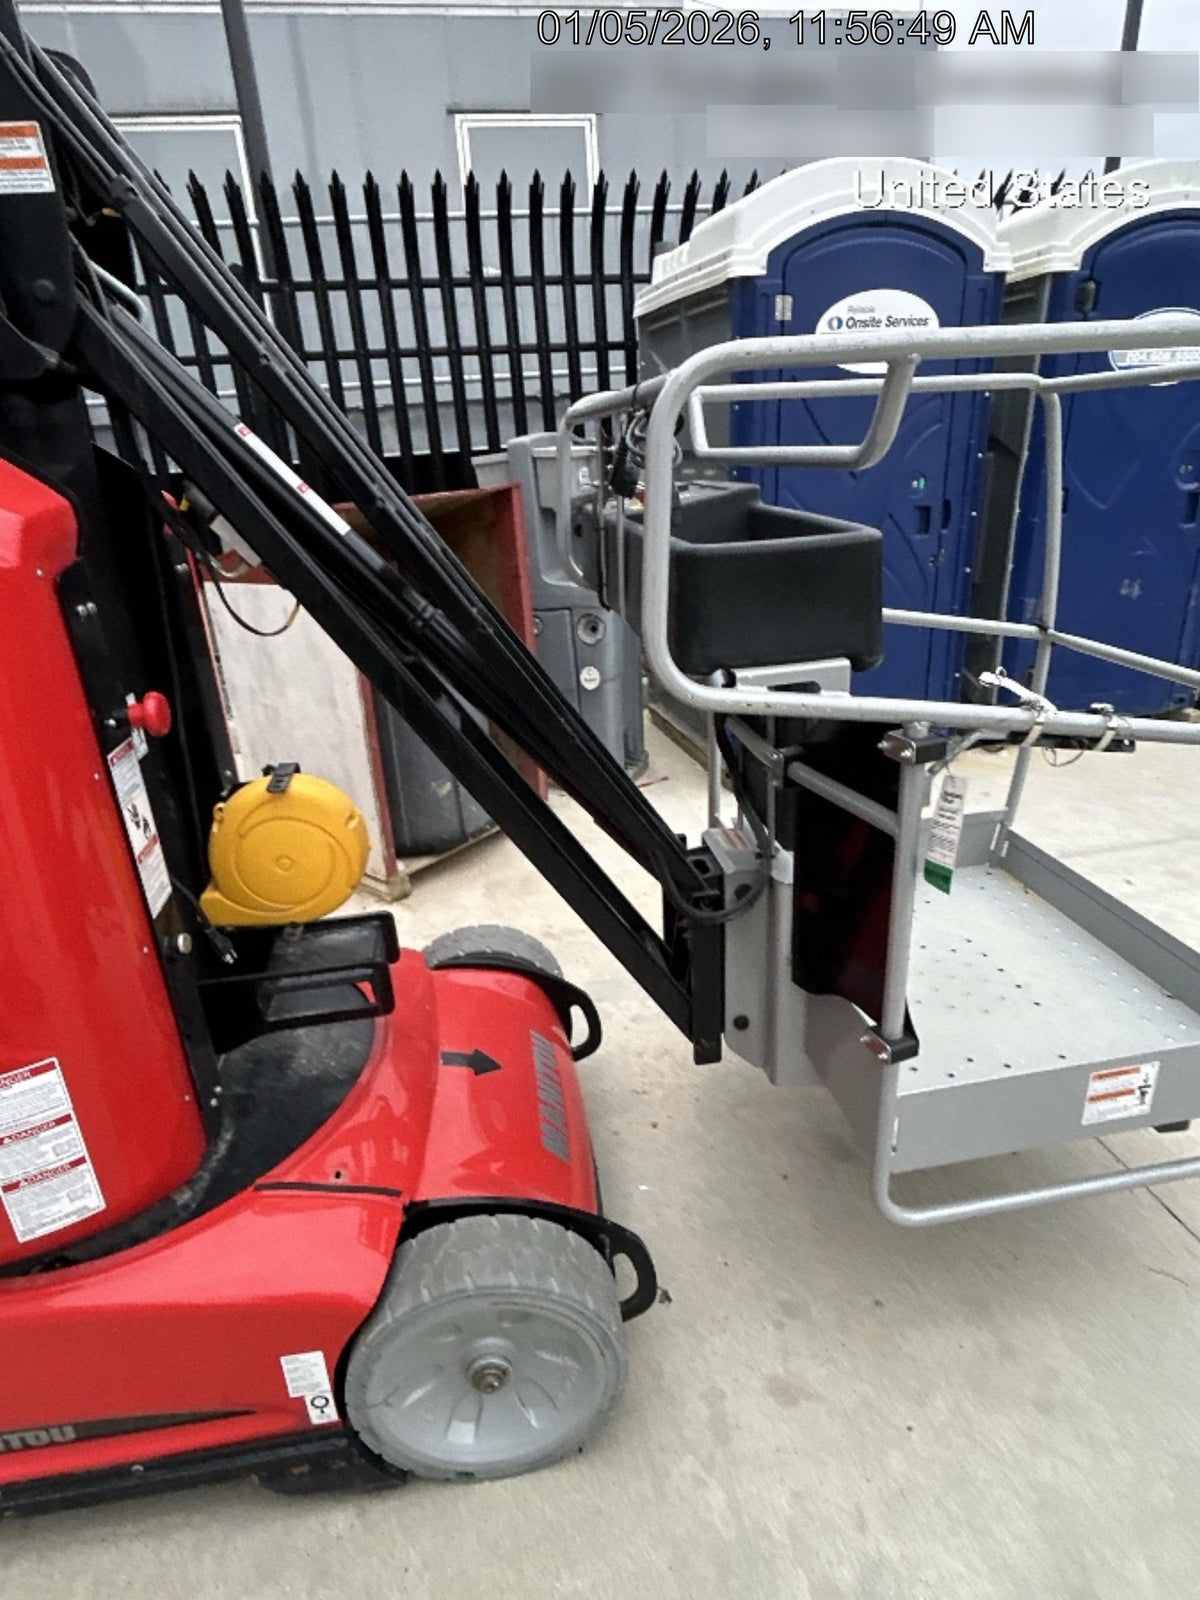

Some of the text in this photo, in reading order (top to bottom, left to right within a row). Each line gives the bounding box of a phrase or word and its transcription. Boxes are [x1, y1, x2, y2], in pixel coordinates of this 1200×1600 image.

[845, 314, 930, 330] Onsite Services
[11, 1120, 56, 1141] DANGER
[27, 1163, 72, 1185] DANGER
